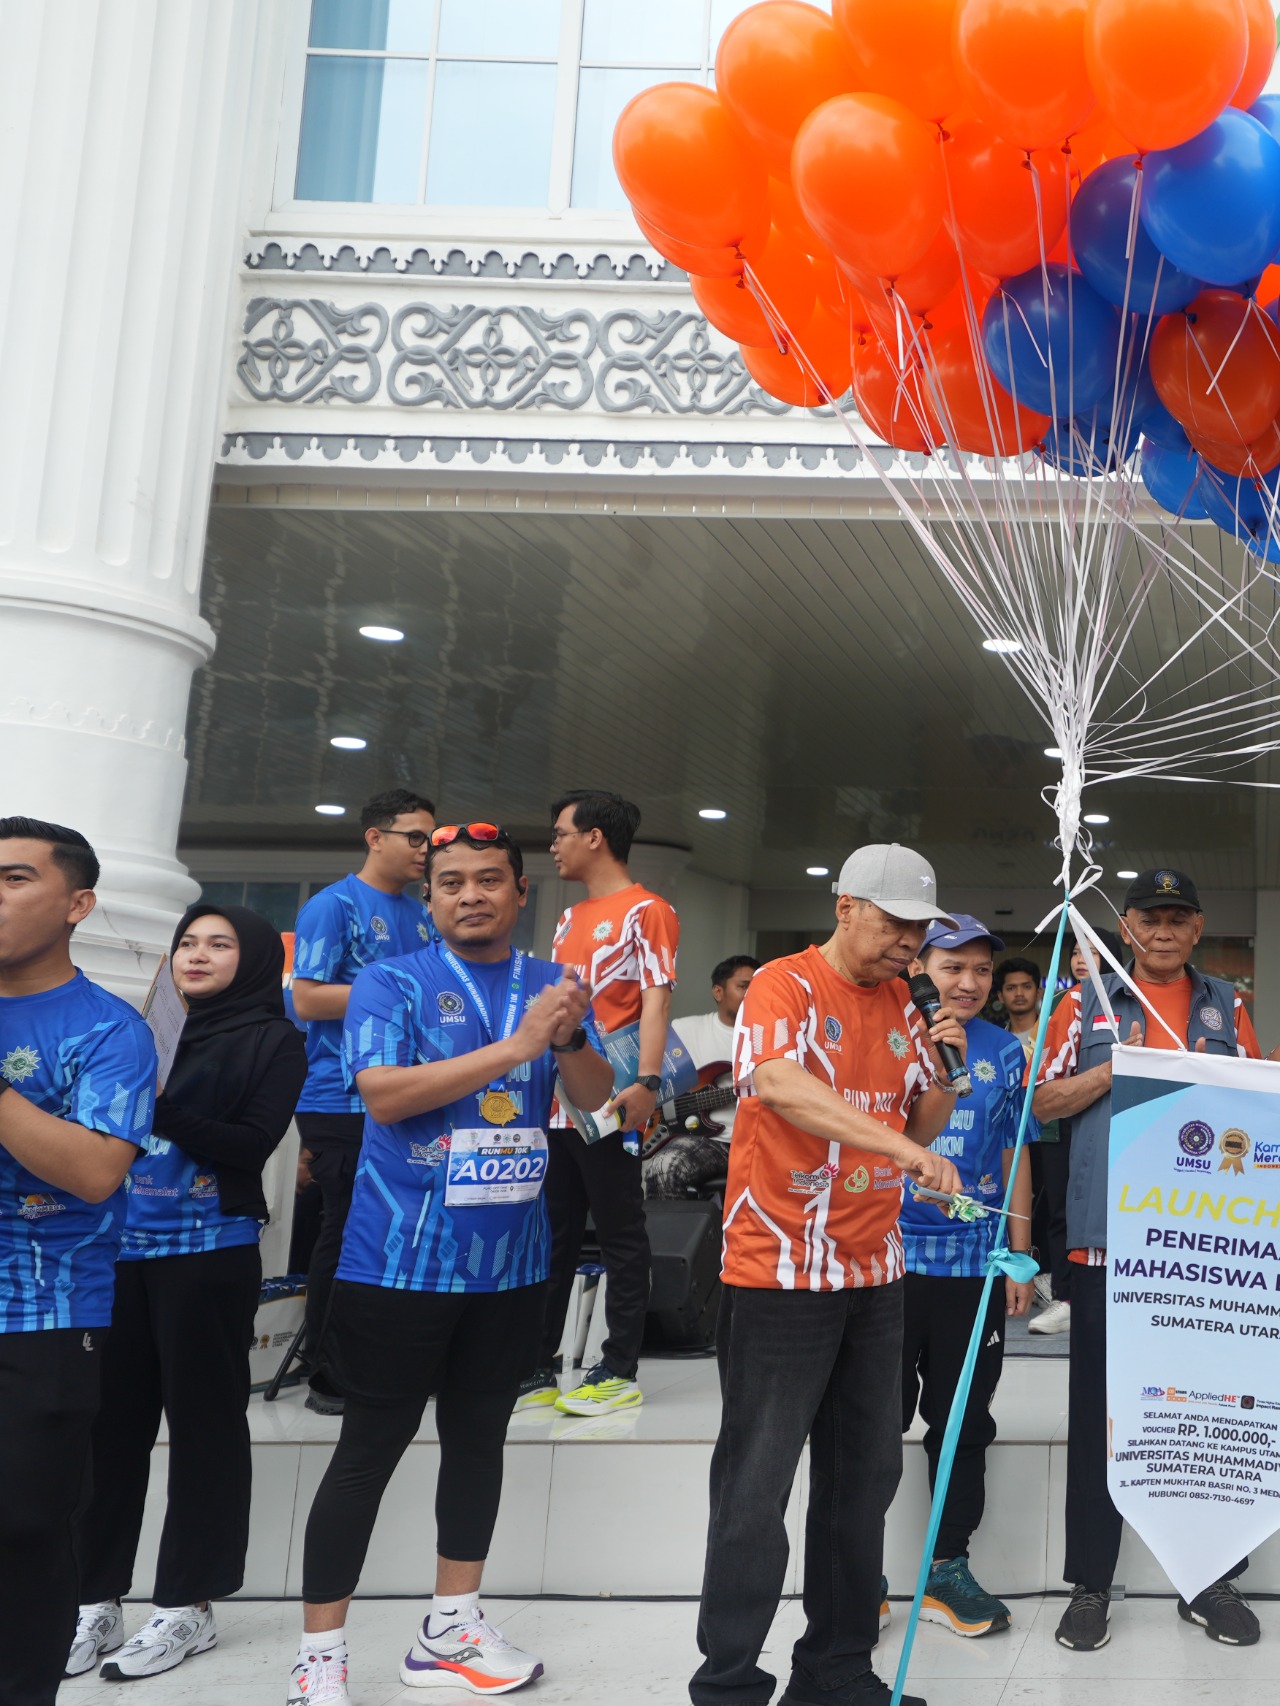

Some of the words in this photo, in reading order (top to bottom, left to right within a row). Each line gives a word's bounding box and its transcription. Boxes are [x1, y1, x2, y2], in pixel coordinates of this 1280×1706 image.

[439, 1015, 466, 1024] UMSU
[873, 1092, 897, 1114] MU
[949, 1109, 975, 1131] MU
[514, 1146, 528, 1154] 10K
[452, 1156, 544, 1182] A0202
[1176, 1156, 1211, 1170] UMSU
[793, 1179, 829, 1188] Indonesia
[1114, 1258, 1267, 1290] MAHASISWA
[1113, 1291, 1205, 1308] UNIVERSITAS
[1150, 1315, 1235, 1334] SUMATERA
[1188, 1390, 1237, 1403] AppliedHE
[1143, 1411, 1182, 1421] SELAMAT
[1184, 1413, 1210, 1423] ANDA
[1211, 1416, 1278, 1431] MENDAPATKAN
[1142, 1426, 1176, 1434] VOUCHER
[1177, 1423, 1200, 1438] RP.
[1203, 1425, 1276, 1448] 1.000.000,-
[1127, 1439, 1168, 1447] SILAHKAN
[1168, 1439, 1205, 1449] DATANG
[1220, 1443, 1257, 1455] KAMPUS
[1115, 1450, 1190, 1462] UNIVERSITAS
[1146, 1462, 1215, 1476] SUMATERA
[1219, 1467, 1262, 1483] UTARA
[1131, 1478, 1162, 1487] KAPTEN
[1163, 1478, 1206, 1488] MUKHTAR
[1208, 1481, 1234, 1491] BASRI
[1236, 1484, 1251, 1494] NO.
[1253, 1487, 1258, 1495] 3
[1148, 1490, 1187, 1499] HUBUNGI
[1189, 1491, 1255, 1506] 0852-7130-4697
